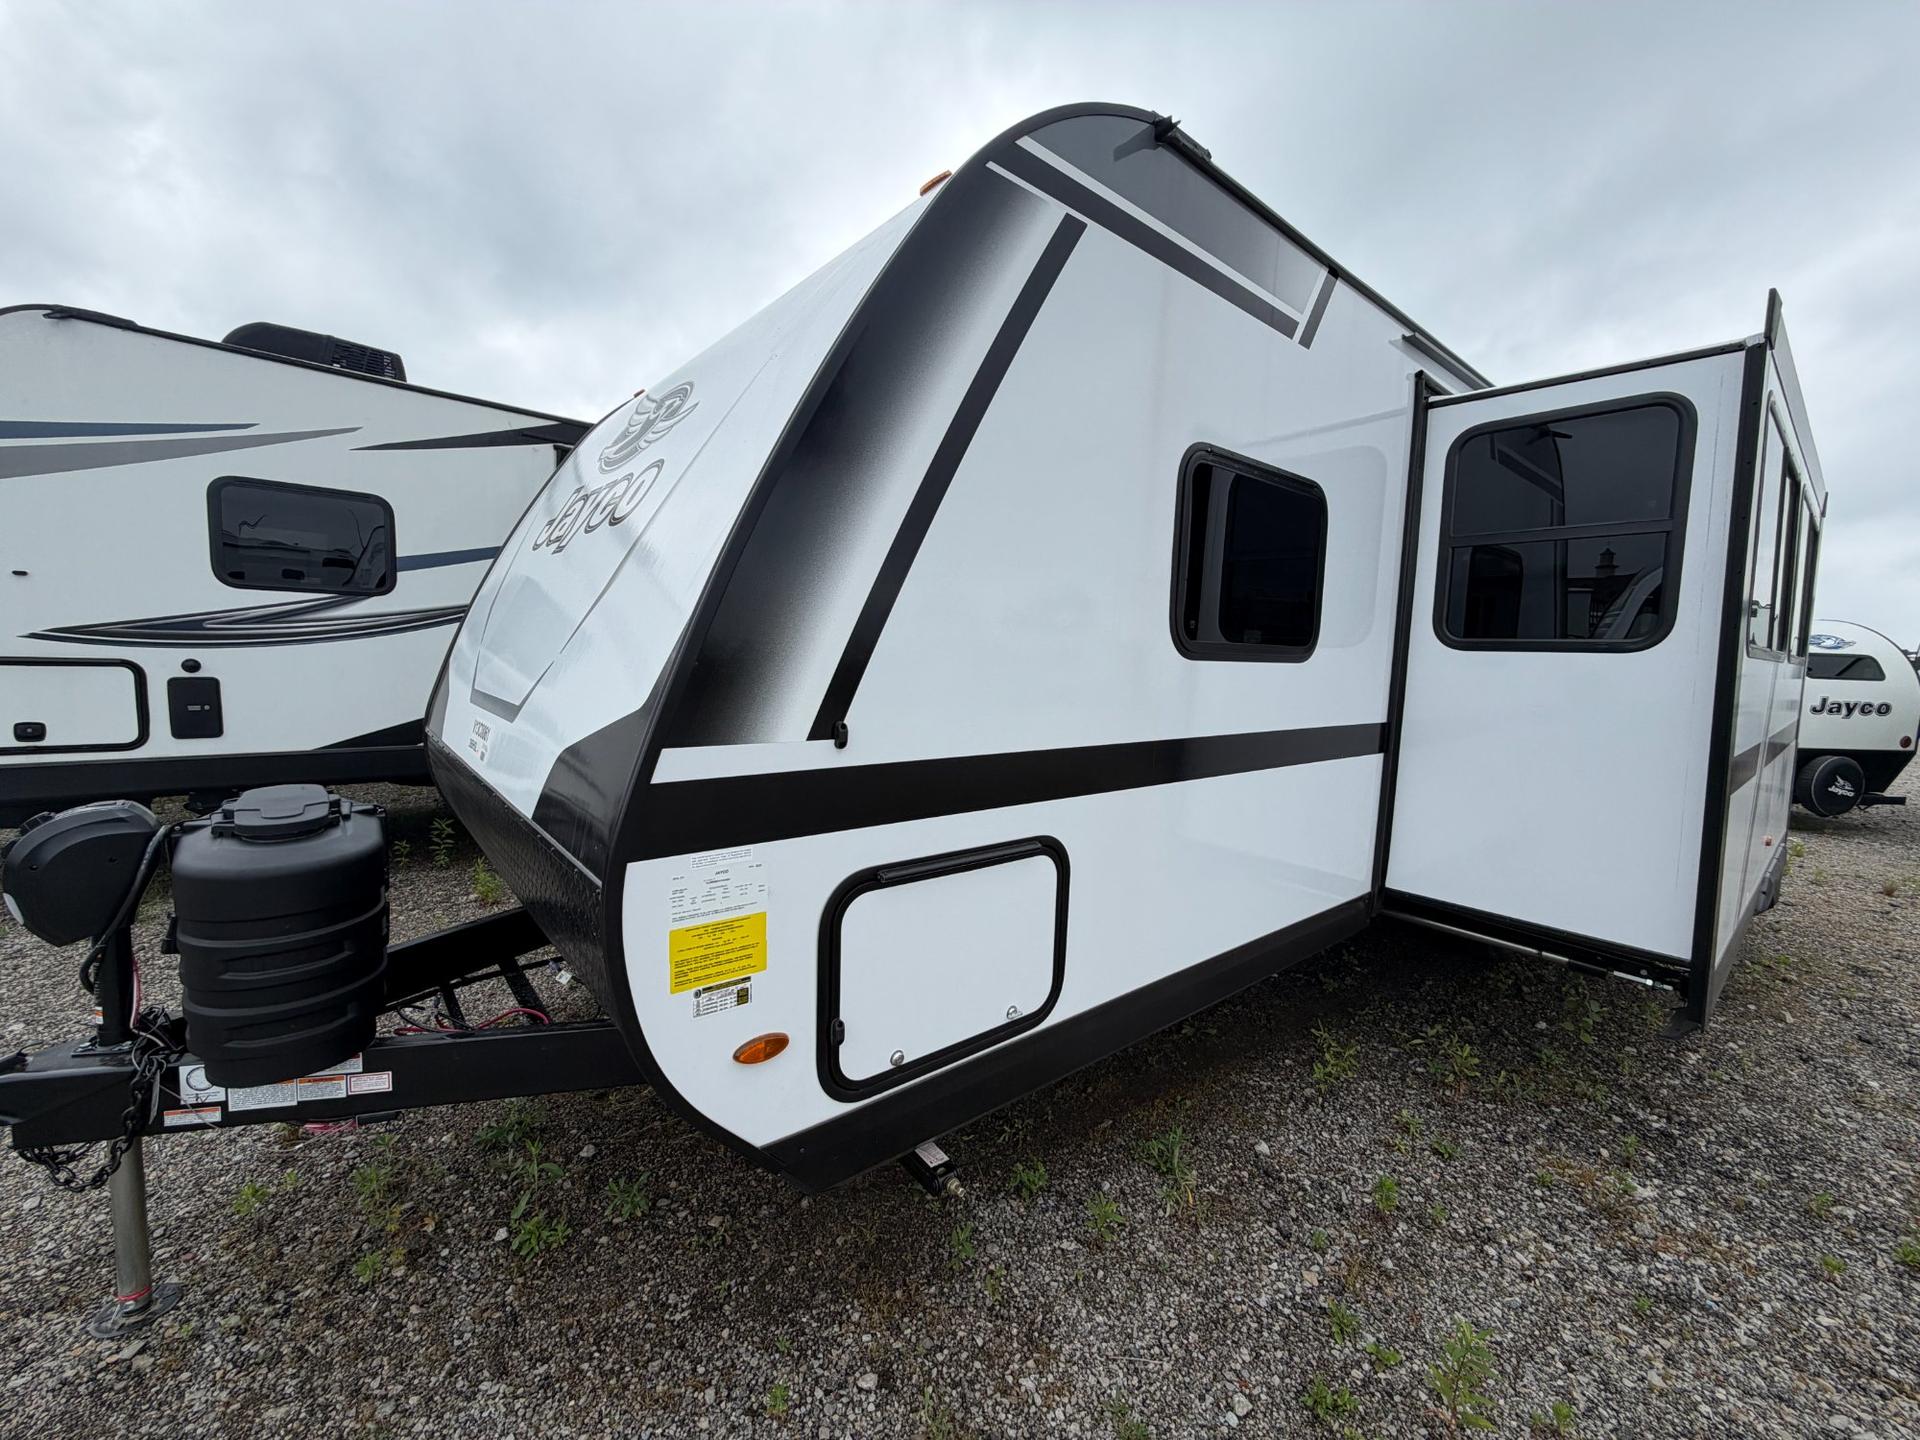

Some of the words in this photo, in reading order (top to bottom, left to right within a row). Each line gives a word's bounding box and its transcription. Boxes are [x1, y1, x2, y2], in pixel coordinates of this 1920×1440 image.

[532, 458, 665, 555] Jayco
[1810, 696, 1892, 719] Jayco
[1828, 786, 1855, 797] Jayco
